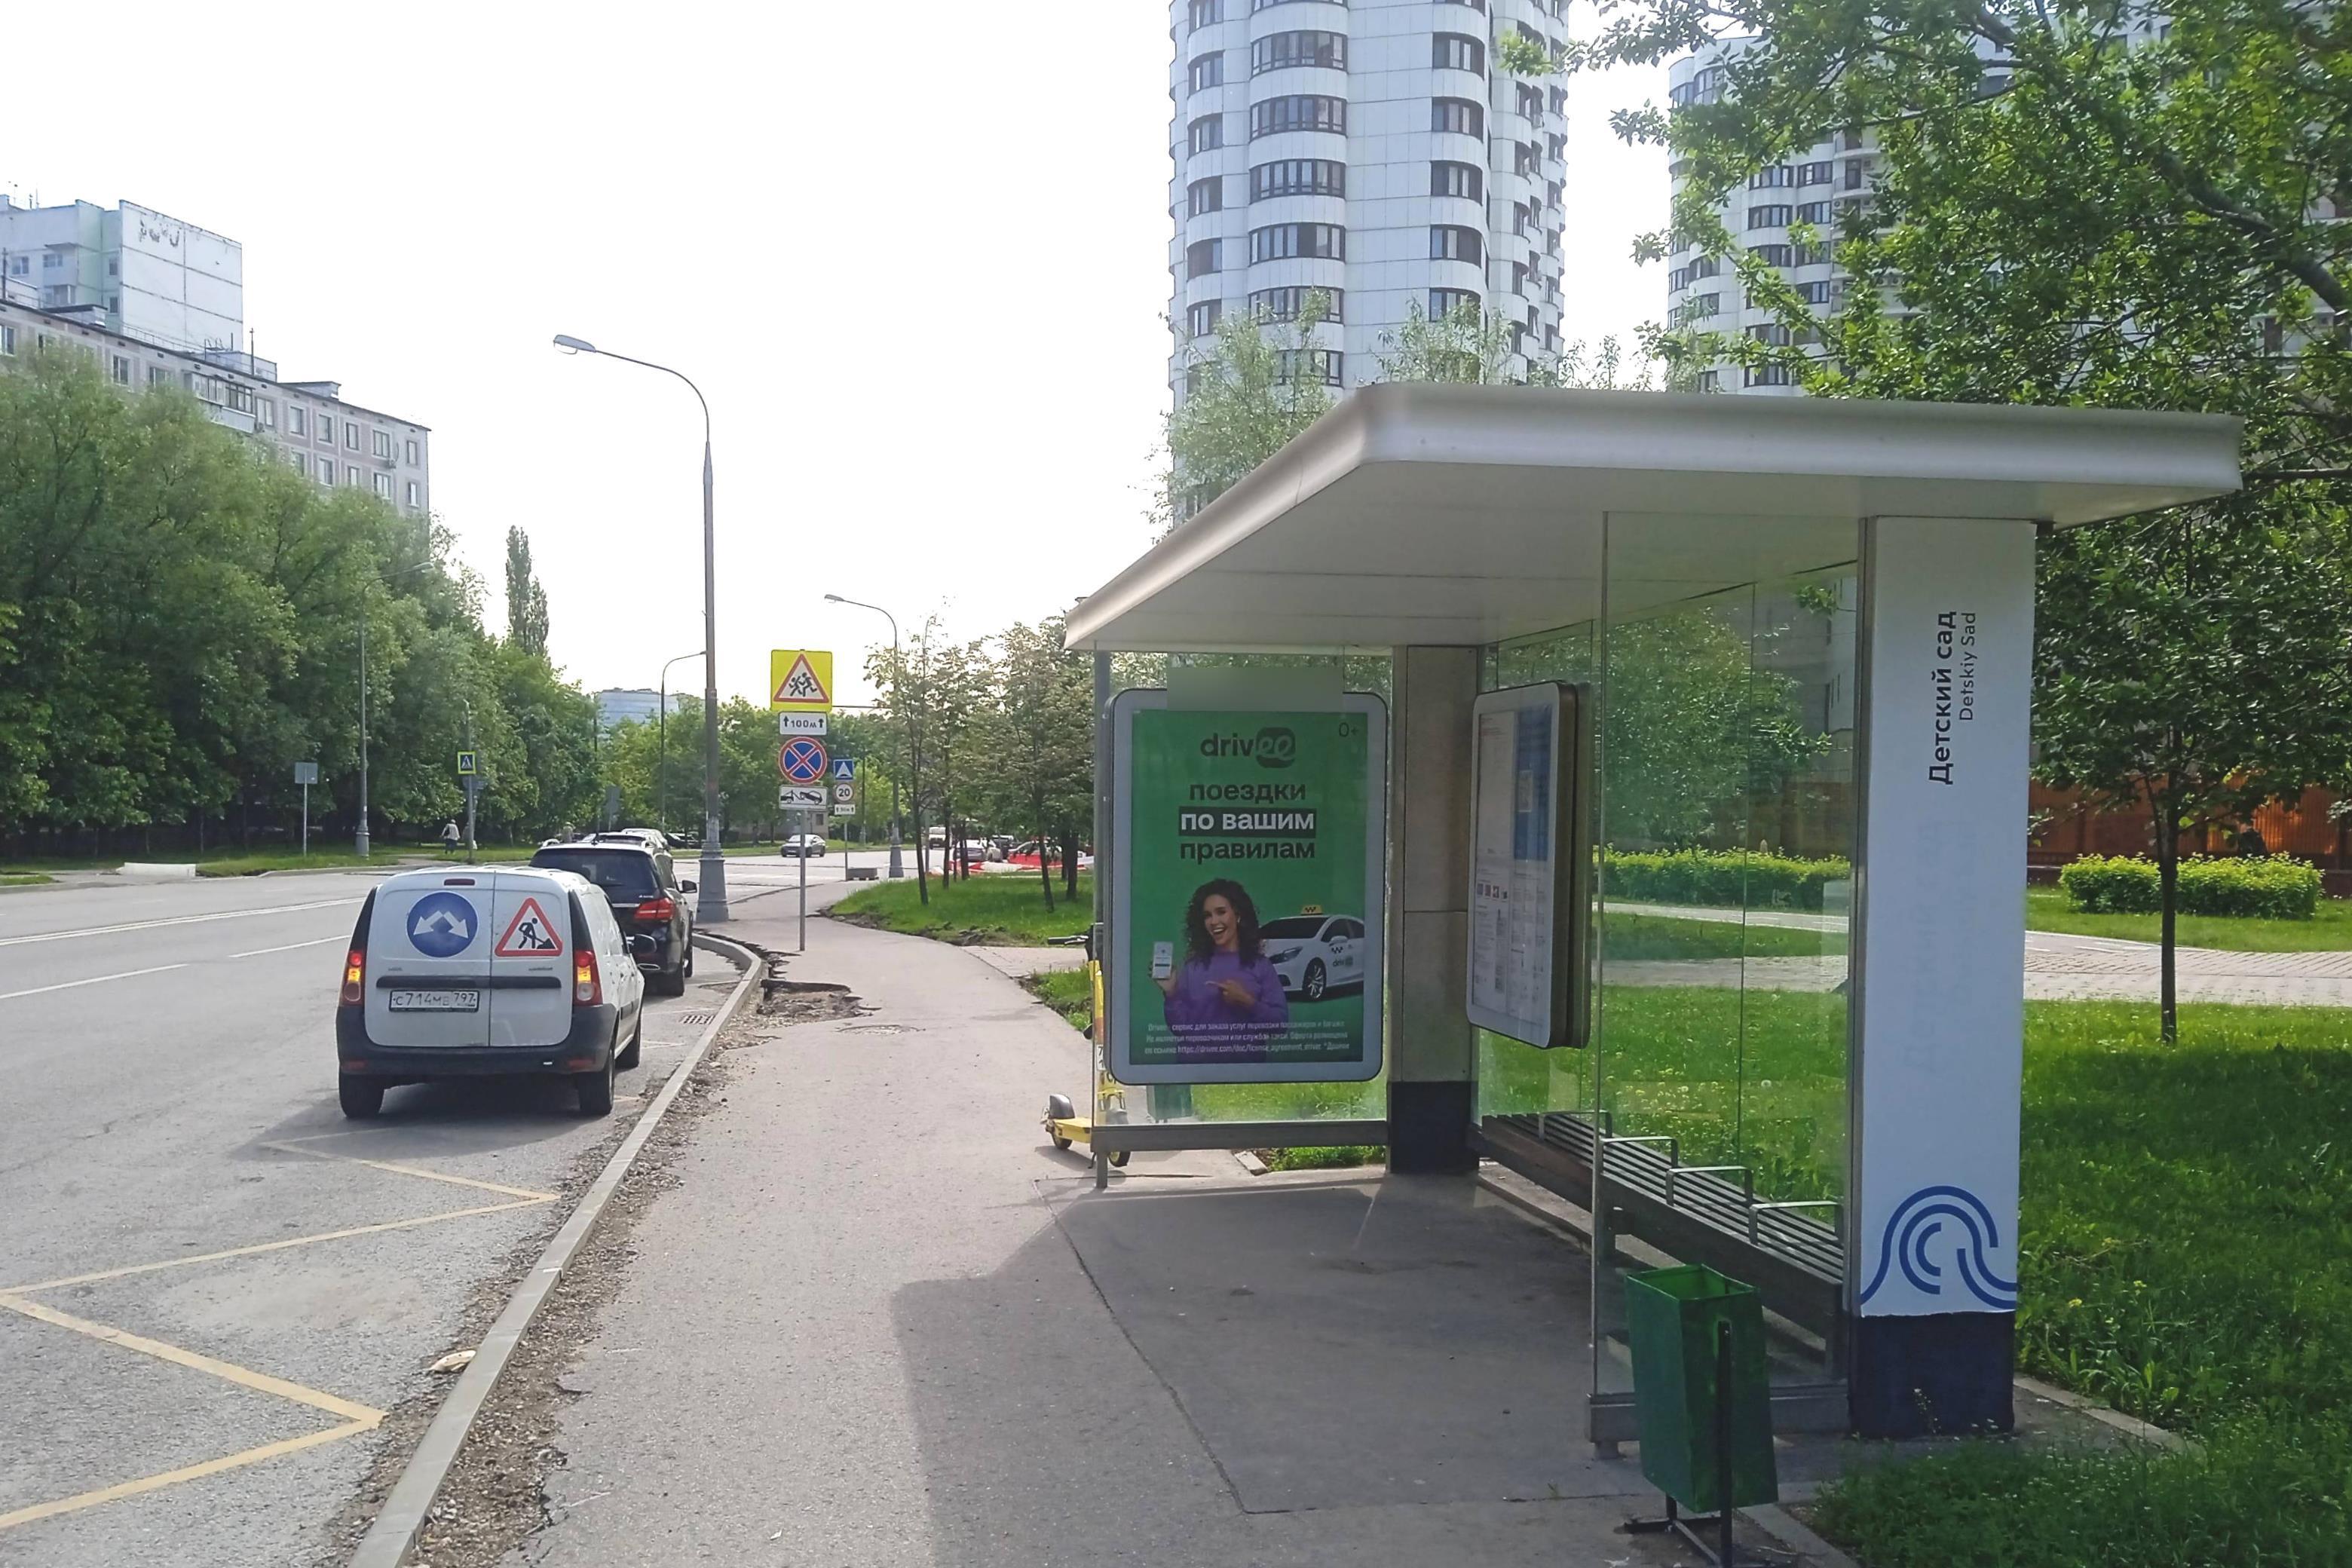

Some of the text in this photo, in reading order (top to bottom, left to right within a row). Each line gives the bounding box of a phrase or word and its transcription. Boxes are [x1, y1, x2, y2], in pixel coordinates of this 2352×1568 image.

[1959, 612, 1977, 721] Detskiy Sad
[1928, 611, 1957, 785] Детский сад
[792, 719, 816, 728] 100м
[1339, 722, 1359, 737] 0+
[1200, 728, 1296, 767] drivee
[838, 788, 850, 797] 20
[1189, 783, 1306, 804] поездки
[1181, 813, 1315, 831] по вашим
[1180, 841, 1315, 865] правилам
[454, 992, 475, 1003] 797
